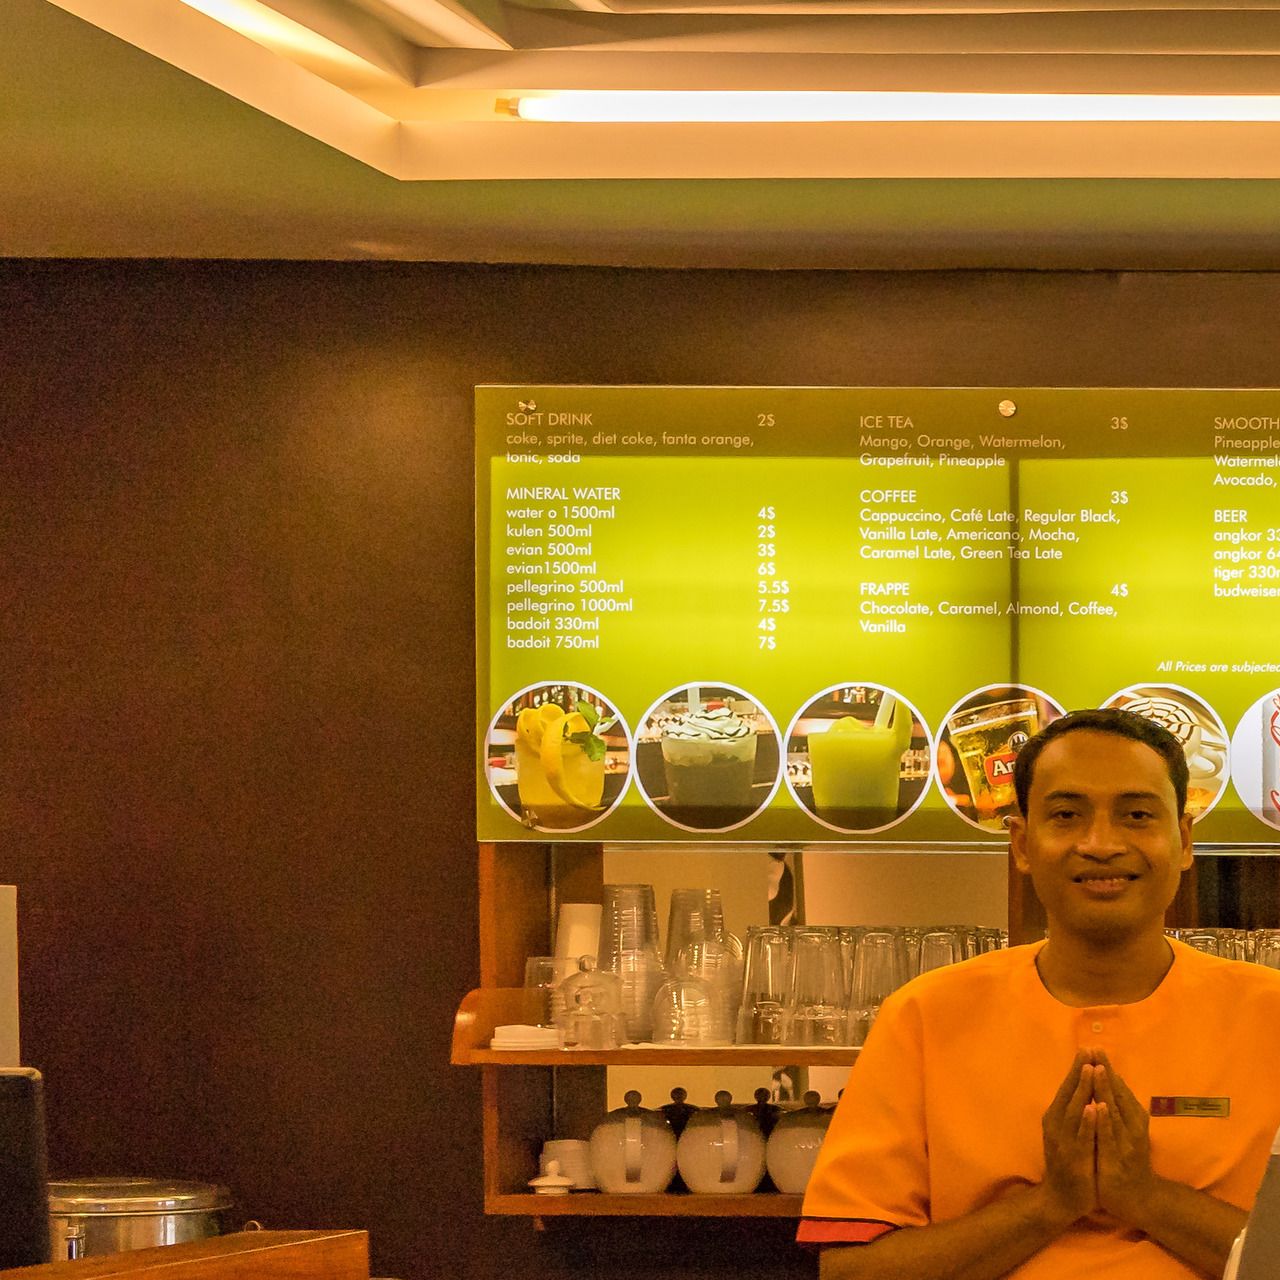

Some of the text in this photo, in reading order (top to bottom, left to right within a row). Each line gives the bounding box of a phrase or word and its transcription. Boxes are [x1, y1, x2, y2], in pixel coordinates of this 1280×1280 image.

[506, 412, 775, 427] SOFT DRINK 2$
[860, 415, 1128, 430] ICE TEA 3$
[506, 431, 754, 448] coke, sprite, diet coke, fanta orange,
[506, 487, 621, 500] MINERAL WATER
[860, 489, 1129, 504] COFFEE 3$
[506, 507, 544, 518] water
[563, 505, 615, 519] 1500ml
[758, 506, 776, 520] 4$
[1214, 509, 1248, 523] BEER
[507, 523, 776, 539] kulen 500ml 2$
[1214, 527, 1262, 545] angkor
[506, 542, 776, 558] evian 500ml 3$
[1214, 546, 1262, 563] angkor
[757, 561, 776, 576] 6$
[1214, 565, 1244, 582] tiger
[507, 579, 790, 596] pellegrino 500ml 5.5$
[860, 582, 1129, 598] FRAPPE 4$
[507, 597, 790, 615] pellegrino 1000ml 7.5$
[507, 616, 776, 632] badoit 330ml 4$
[507, 634, 777, 650] badoit 750ml 7$
